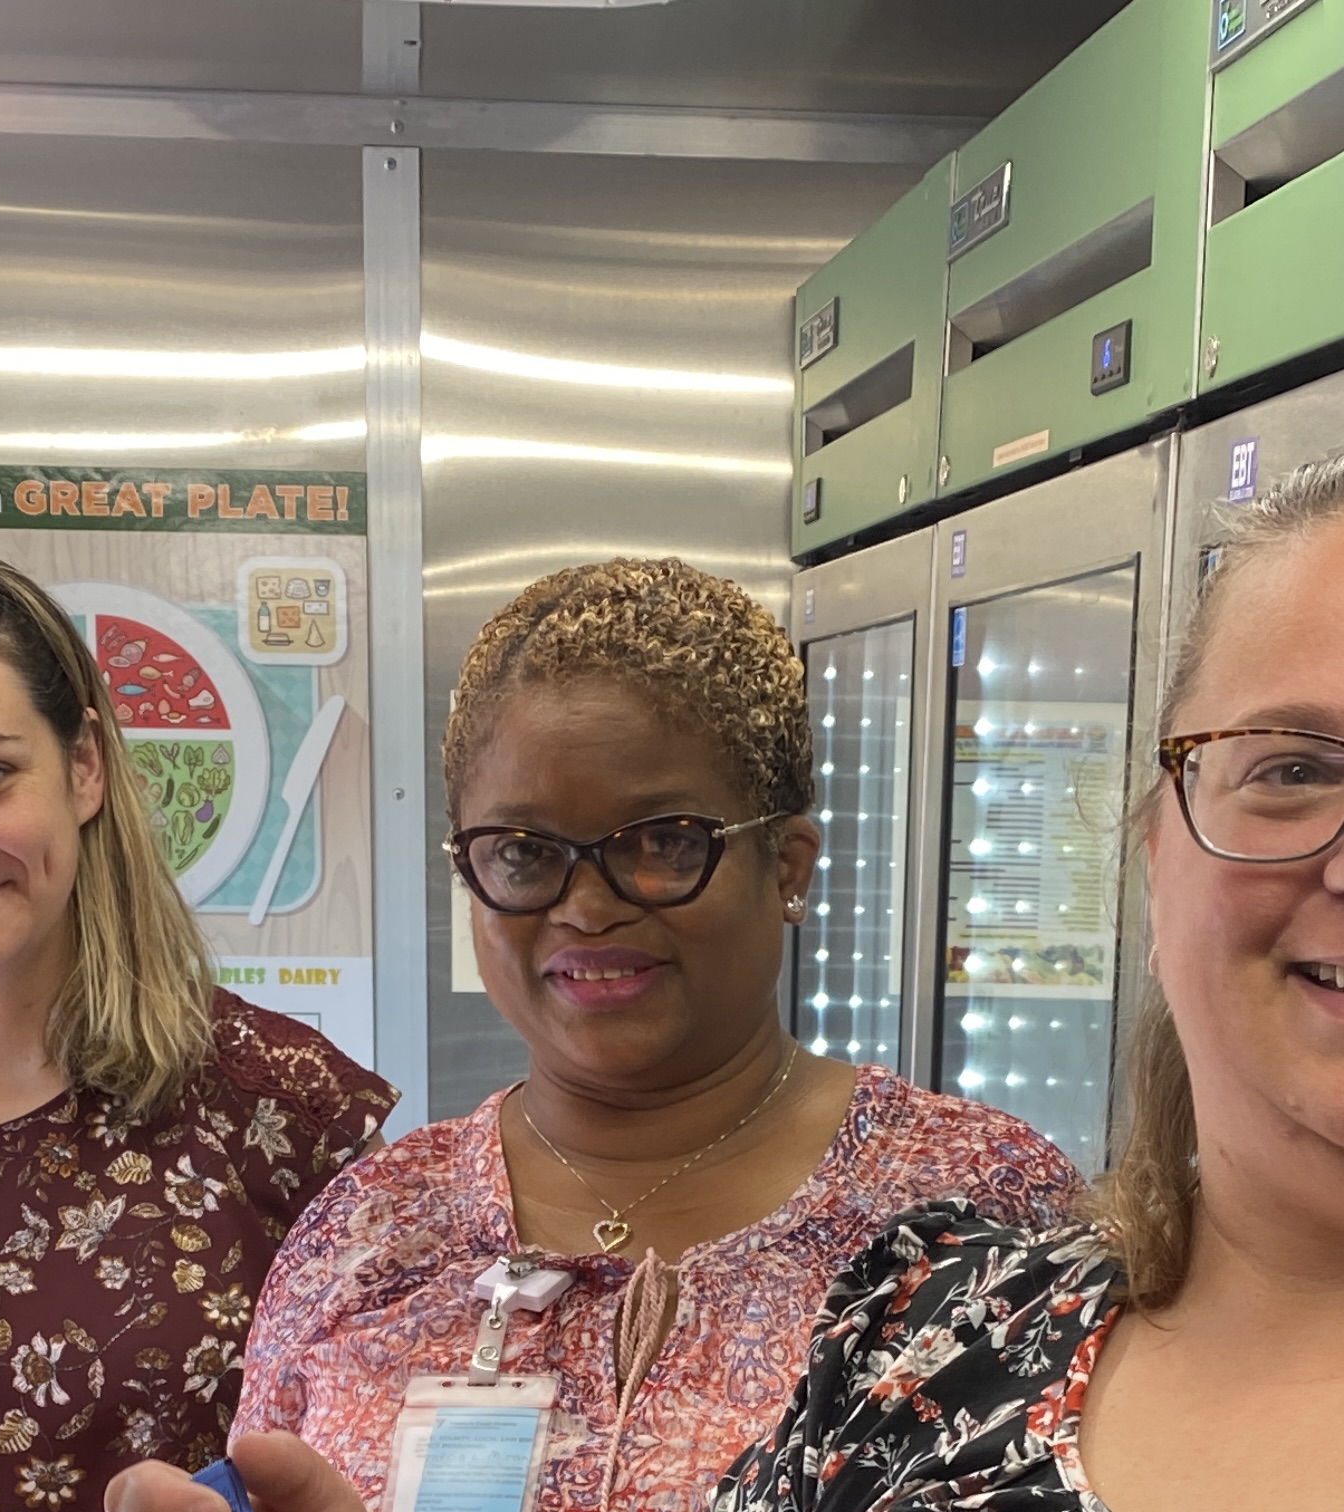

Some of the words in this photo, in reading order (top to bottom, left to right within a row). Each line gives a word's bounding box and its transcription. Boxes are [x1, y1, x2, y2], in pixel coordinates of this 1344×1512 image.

[1231, 441, 1255, 489] EBT
[13, 480, 174, 518] GREAT
[186, 485, 350, 522] PLATE!
[278, 967, 343, 985] DAIRY
